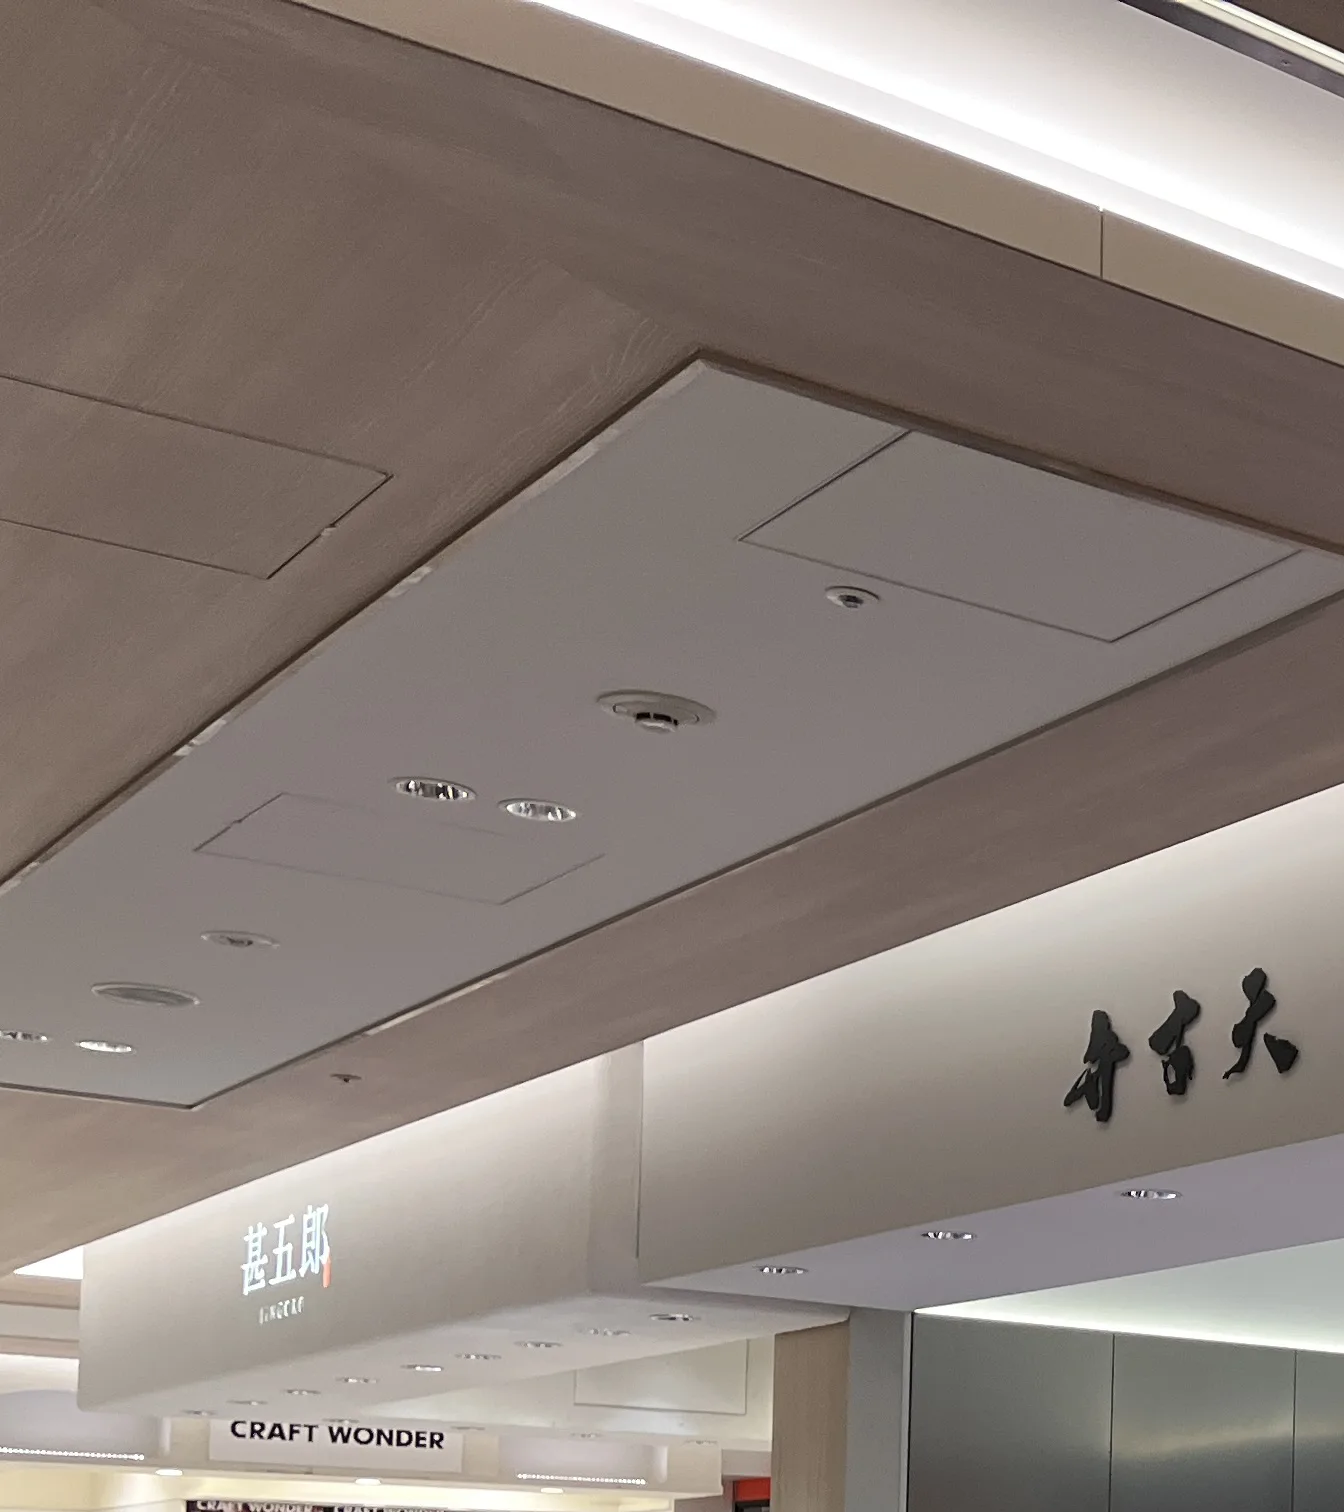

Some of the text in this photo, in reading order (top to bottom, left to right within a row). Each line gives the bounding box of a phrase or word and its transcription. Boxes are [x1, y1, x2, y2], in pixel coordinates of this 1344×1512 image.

[241, 1204, 331, 1296] 甚五郎
[230, 1420, 444, 1449] CRAFT WONDER
[197, 1500, 244, 1512] CRAFT
